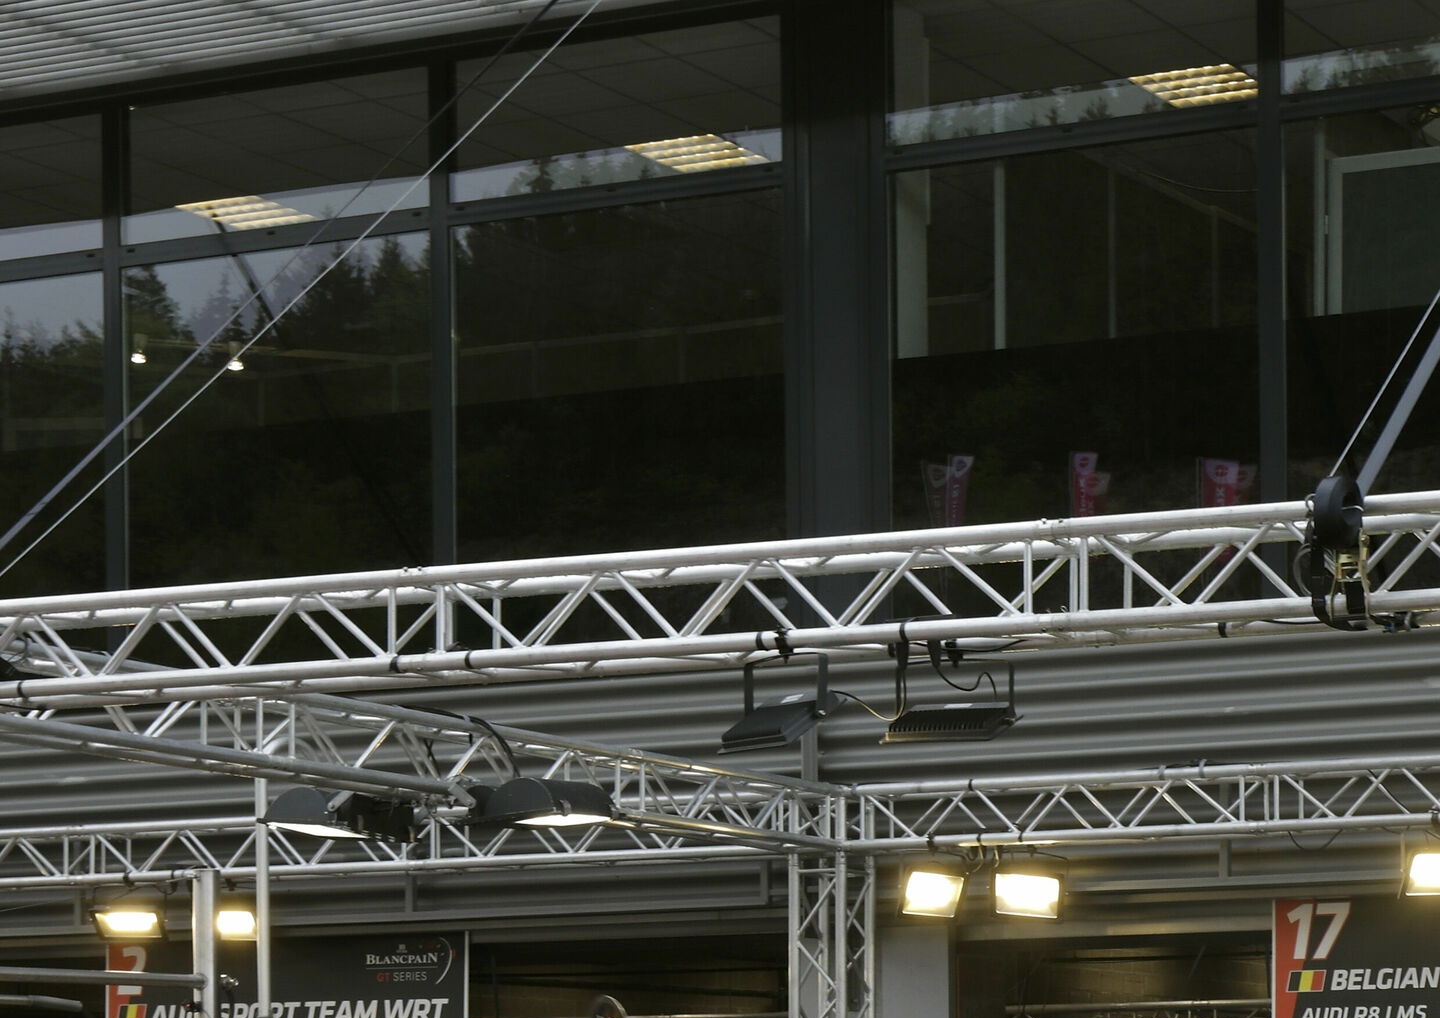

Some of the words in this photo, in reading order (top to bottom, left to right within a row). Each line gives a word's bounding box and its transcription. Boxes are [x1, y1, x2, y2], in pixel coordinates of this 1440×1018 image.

[1286, 901, 1350, 960] 17
[366, 952, 438, 965] BLANCPAIN
[377, 971, 390, 982] GT
[392, 971, 428, 982] SERIES
[1330, 966, 1439, 991] BELGIAN
